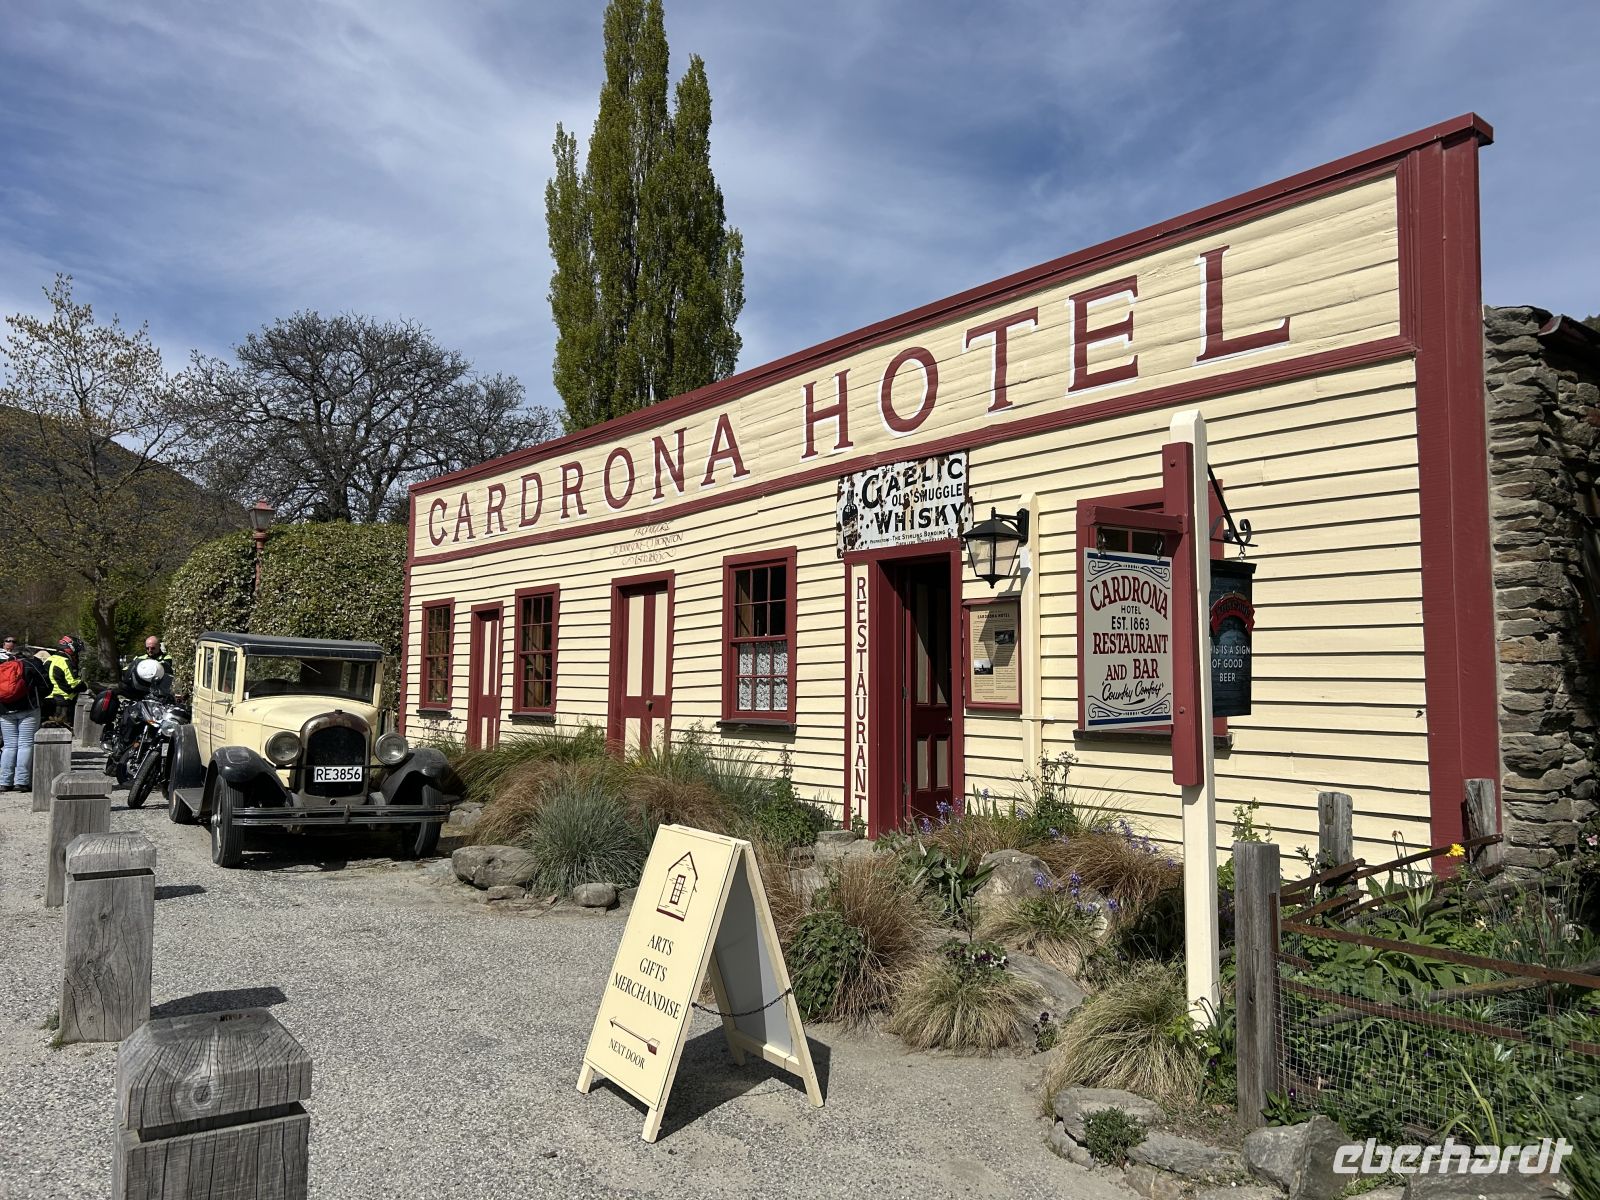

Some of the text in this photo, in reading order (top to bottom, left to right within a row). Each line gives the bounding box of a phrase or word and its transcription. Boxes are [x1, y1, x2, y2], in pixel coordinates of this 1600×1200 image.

[428, 245, 1291, 548] CARDRONA HOTEL
[862, 458, 964, 509] GAELIC
[874, 502, 965, 535] WHISKY
[1090, 575, 1168, 620] CARDRONA
[1121, 605, 1141, 615] HOTEL
[1111, 616, 1150, 631] EST. 1863
[1093, 633, 1168, 654] RESTAURANT
[1229, 645, 1234, 655] A
[1235, 645, 1250, 655] SIGN
[1105, 658, 1160, 681] AND BAR
[1212, 658, 1243, 669] OF GOOD
[1219, 672, 1236, 682] BEER
[855, 576, 868, 818] RESTAURANT
[315, 768, 361, 781] RE3856
[647, 933, 674, 956] ARTS
[639, 957, 668, 983] GIFTS
[613, 973, 680, 1019] MERCHANDISE
[608, 1037, 645, 1070] NEXT DOOR
